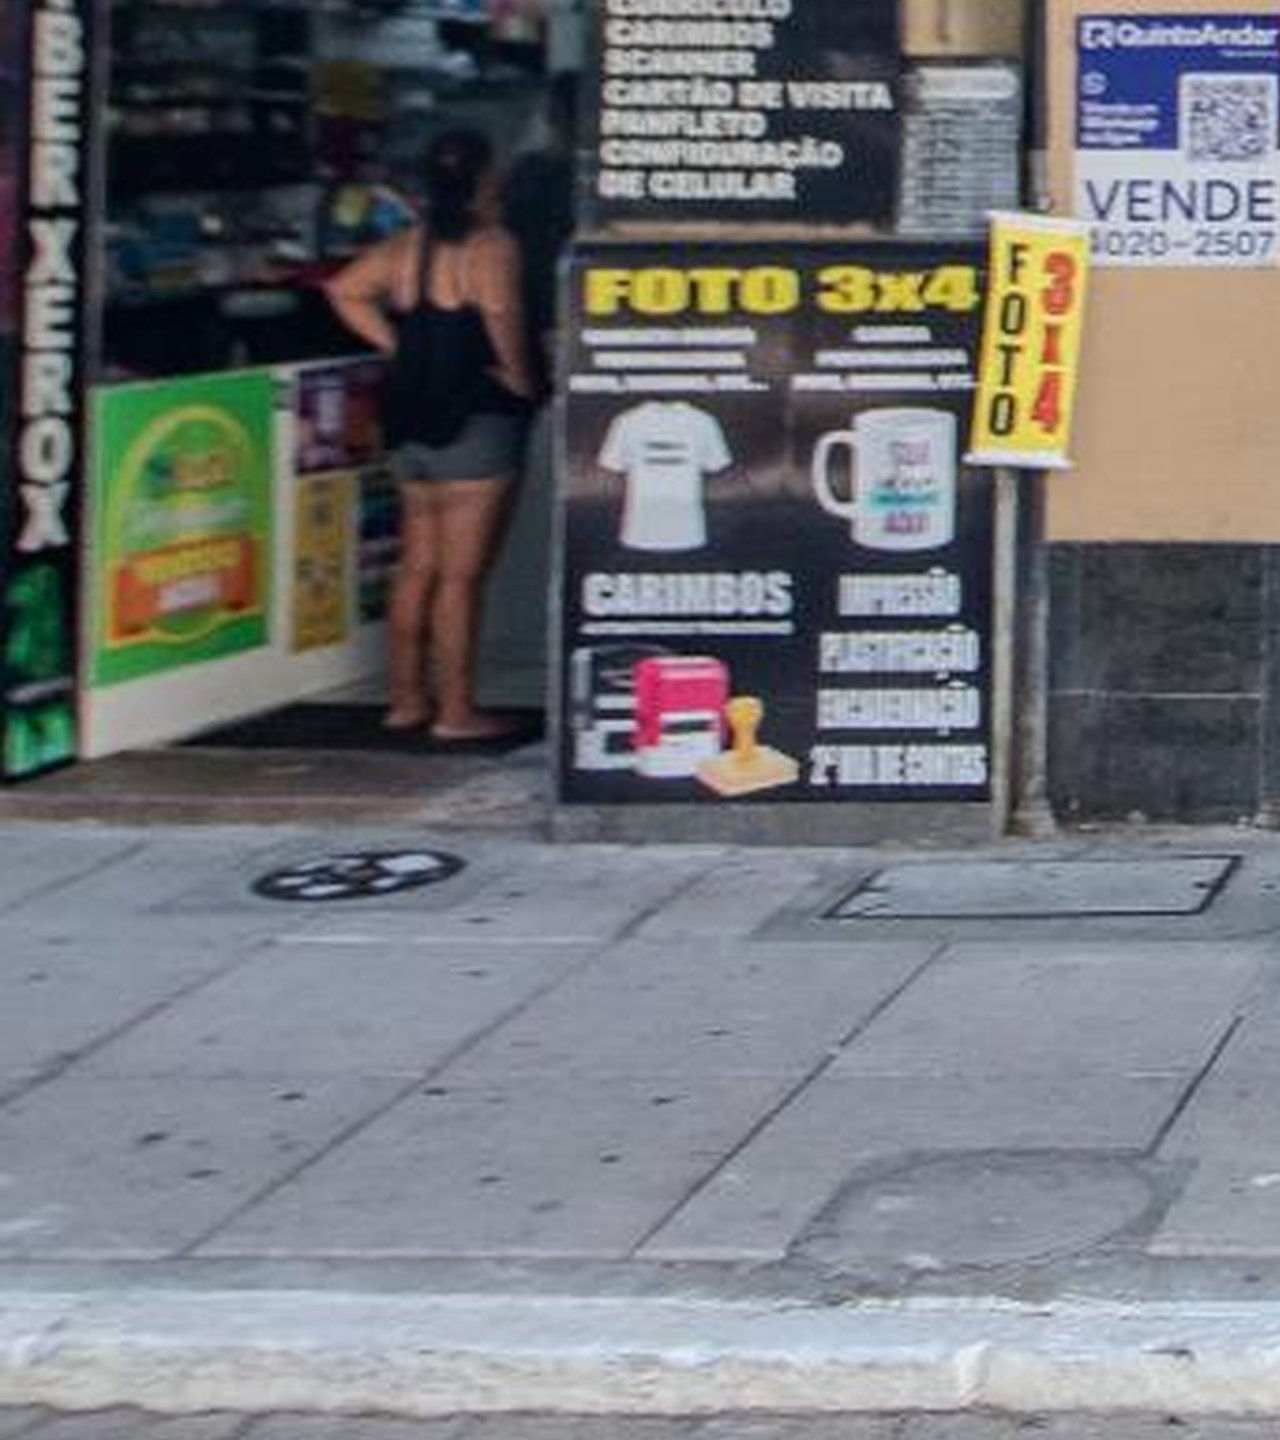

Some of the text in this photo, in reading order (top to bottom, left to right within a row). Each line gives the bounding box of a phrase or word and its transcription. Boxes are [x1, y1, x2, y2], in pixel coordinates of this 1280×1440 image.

[737, 82, 785, 108] DE
[787, 82, 893, 108] VISITA
[599, 171, 796, 199] DE CELULAR
[1085, 179, 1276, 222] VENDE
[583, 267, 799, 315] FOTO
[988, 241, 1031, 437] FOTO
[16, 218, 77, 554] XEROX
[581, 571, 794, 616] CARIMBOS
